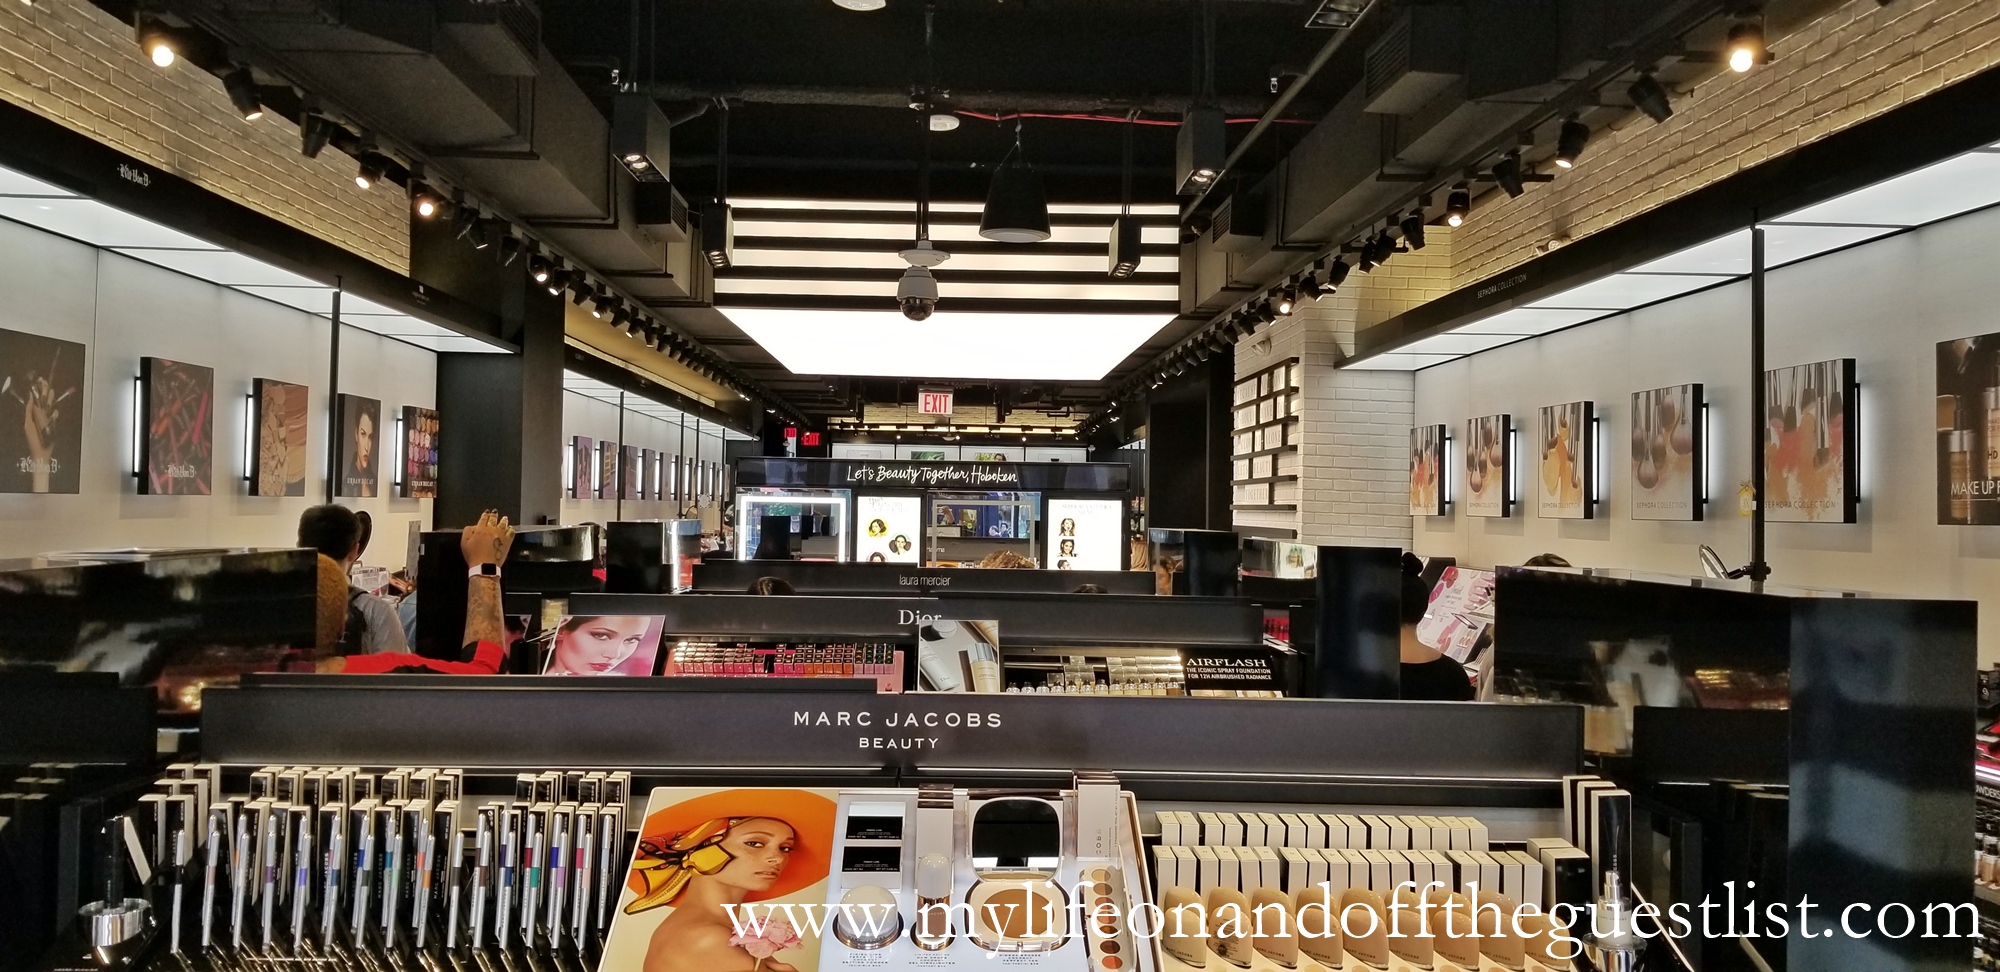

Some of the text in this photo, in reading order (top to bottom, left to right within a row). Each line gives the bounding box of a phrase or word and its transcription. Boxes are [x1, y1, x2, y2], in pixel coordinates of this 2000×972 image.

[1477, 273, 1526, 298] SEPHORA COLLECTION
[924, 394, 949, 413] EXIT
[804, 432, 820, 446] EXIT
[1988, 451, 1998, 460] HD
[847, 464, 1018, 484] Let's Beauty Together, Hoboken
[347, 477, 361, 486] URBAN
[1951, 481, 1979, 495] MAKE
[1982, 481, 1995, 495] UP
[1764, 500, 1835, 509] SEPHORA COLLECTION
[900, 574, 951, 586] laura mercier
[898, 609, 942, 625] Dior
[1186, 658, 1267, 667] AIRFLASH
[794, 711, 1002, 728] MARC JACOBS
[859, 737, 939, 749] BEAUTY
